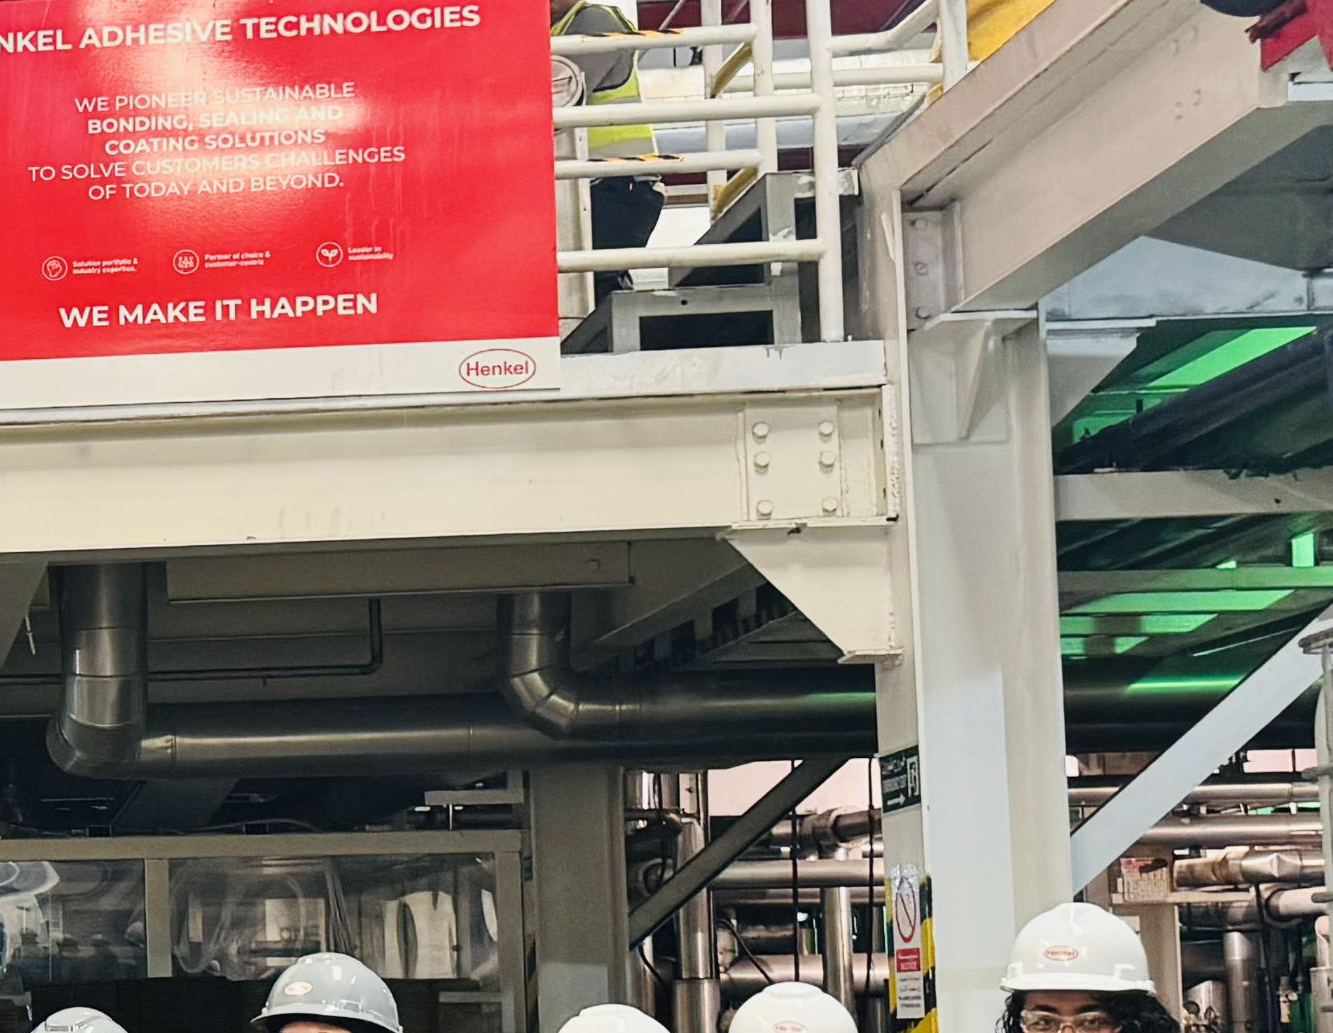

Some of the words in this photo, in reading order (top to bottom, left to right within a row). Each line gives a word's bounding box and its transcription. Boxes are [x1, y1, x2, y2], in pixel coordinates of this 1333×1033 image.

[79, 19, 232, 48] ADHESIVE
[241, 4, 481, 40] TECHNOLOGIES
[74, 97, 109, 113] WE
[115, 91, 207, 111] PIONEER
[212, 82, 355, 106] SUSTAINABLE
[87, 114, 193, 134] BONDING,
[199, 109, 289, 128] SEALING
[295, 104, 344, 123] AND
[105, 135, 199, 155] COATING
[204, 128, 326, 150] SOLUTIONS
[28, 166, 56, 182] TO
[61, 163, 126, 179] SOLVE
[132, 154, 260, 176] CUSTOMERS
[265, 146, 406, 169] CHALLENGES
[88, 185, 117, 201] OF
[122, 180, 192, 198] TODAY
[197, 177, 245, 194] AND
[250, 172, 344, 191] BEYOND.
[58, 306, 110, 328] WE
[118, 302, 207, 325] MAKE
[215, 299, 242, 320] IT
[250, 293, 378, 319] HAPPEN
[466, 360, 529, 376] Henkel
